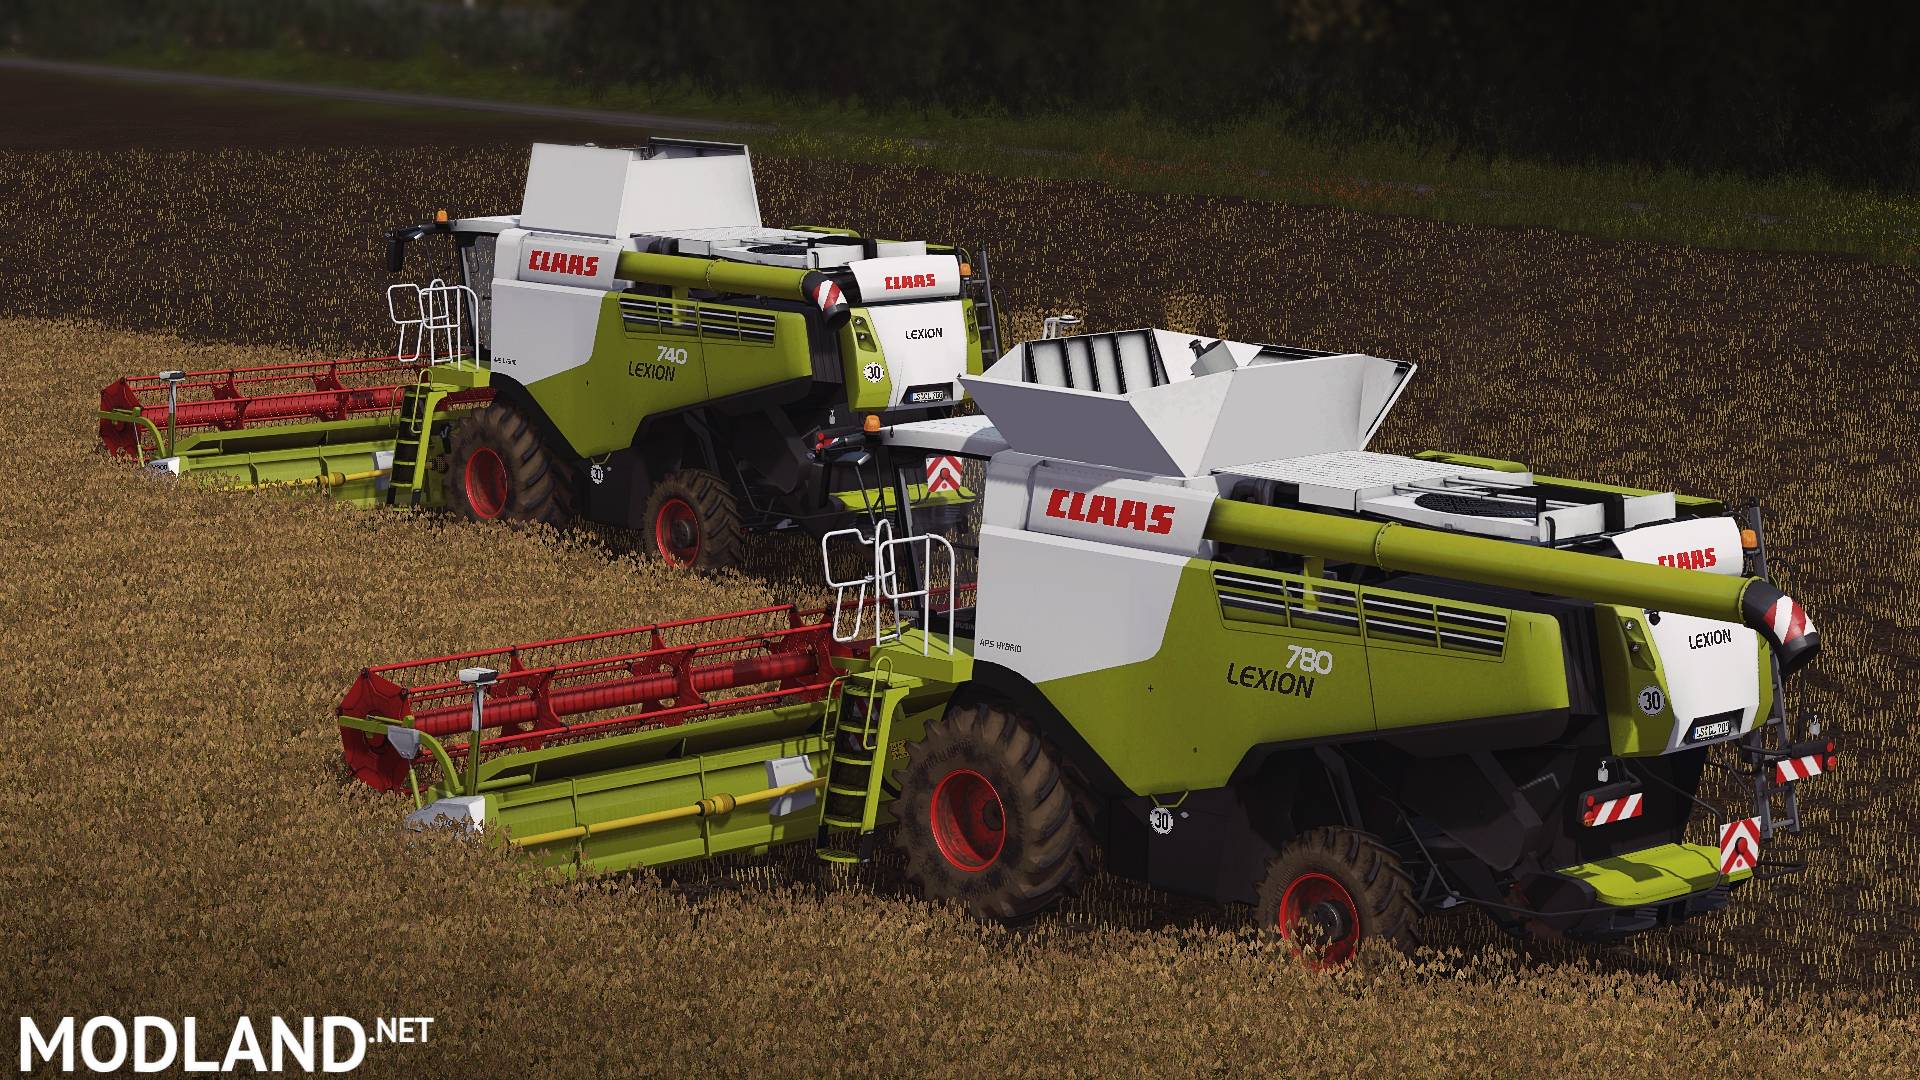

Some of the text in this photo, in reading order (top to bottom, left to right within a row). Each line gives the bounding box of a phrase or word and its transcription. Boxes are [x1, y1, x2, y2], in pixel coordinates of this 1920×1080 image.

[528, 250, 599, 277] CLAAS
[884, 273, 936, 290] CLAAS
[905, 327, 943, 340] LEXION
[657, 345, 688, 365] 740
[628, 360, 676, 382] LEXION
[865, 365, 881, 380] 30
[1045, 489, 1175, 535] CLAAS
[979, 638, 1022, 653] APS HYBRID
[1688, 628, 1732, 650] LEXION
[1285, 644, 1333, 675] 780
[1226, 661, 1316, 699] LEXION
[1642, 690, 1661, 711] 30
[1154, 810, 1169, 831] 30
